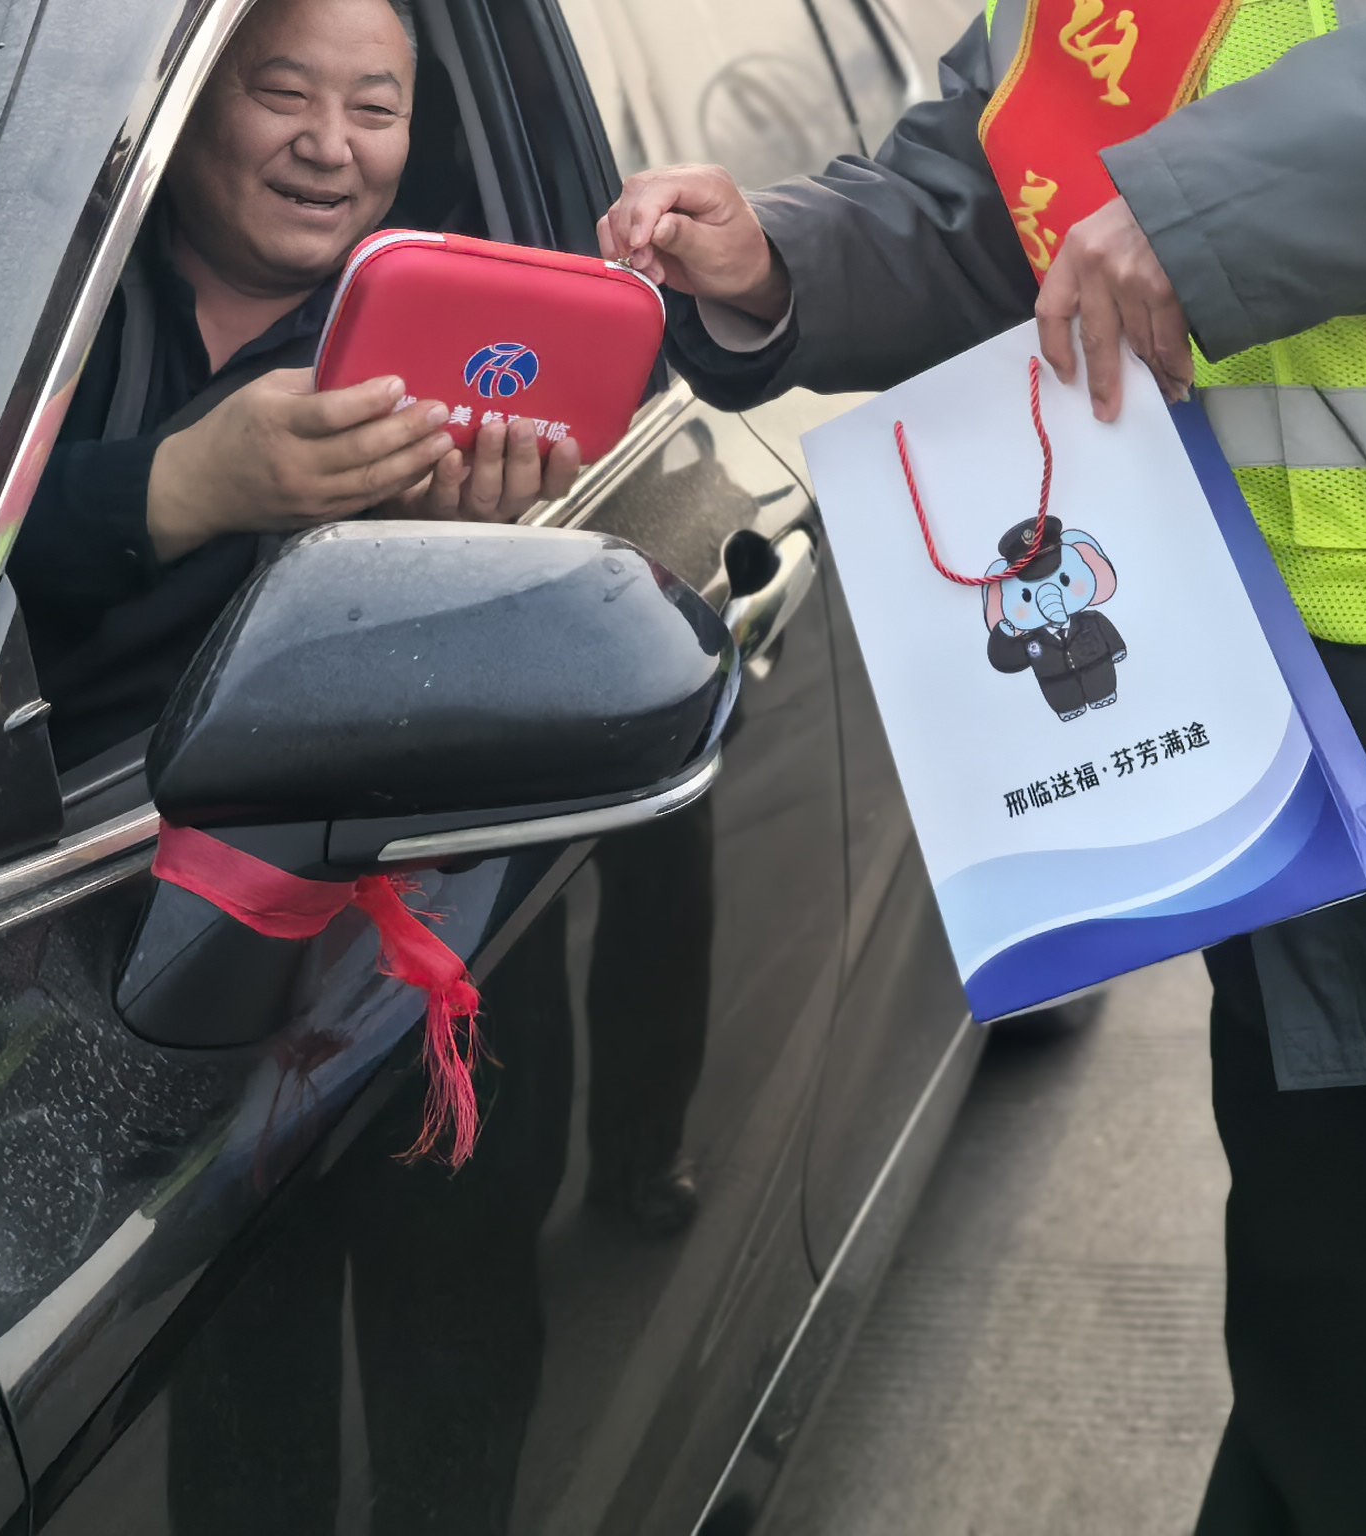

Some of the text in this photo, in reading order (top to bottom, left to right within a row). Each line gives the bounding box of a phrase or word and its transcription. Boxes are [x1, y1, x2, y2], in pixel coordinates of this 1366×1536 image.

[1003, 721, 1211, 818] 邢临送福·芬芳满途
